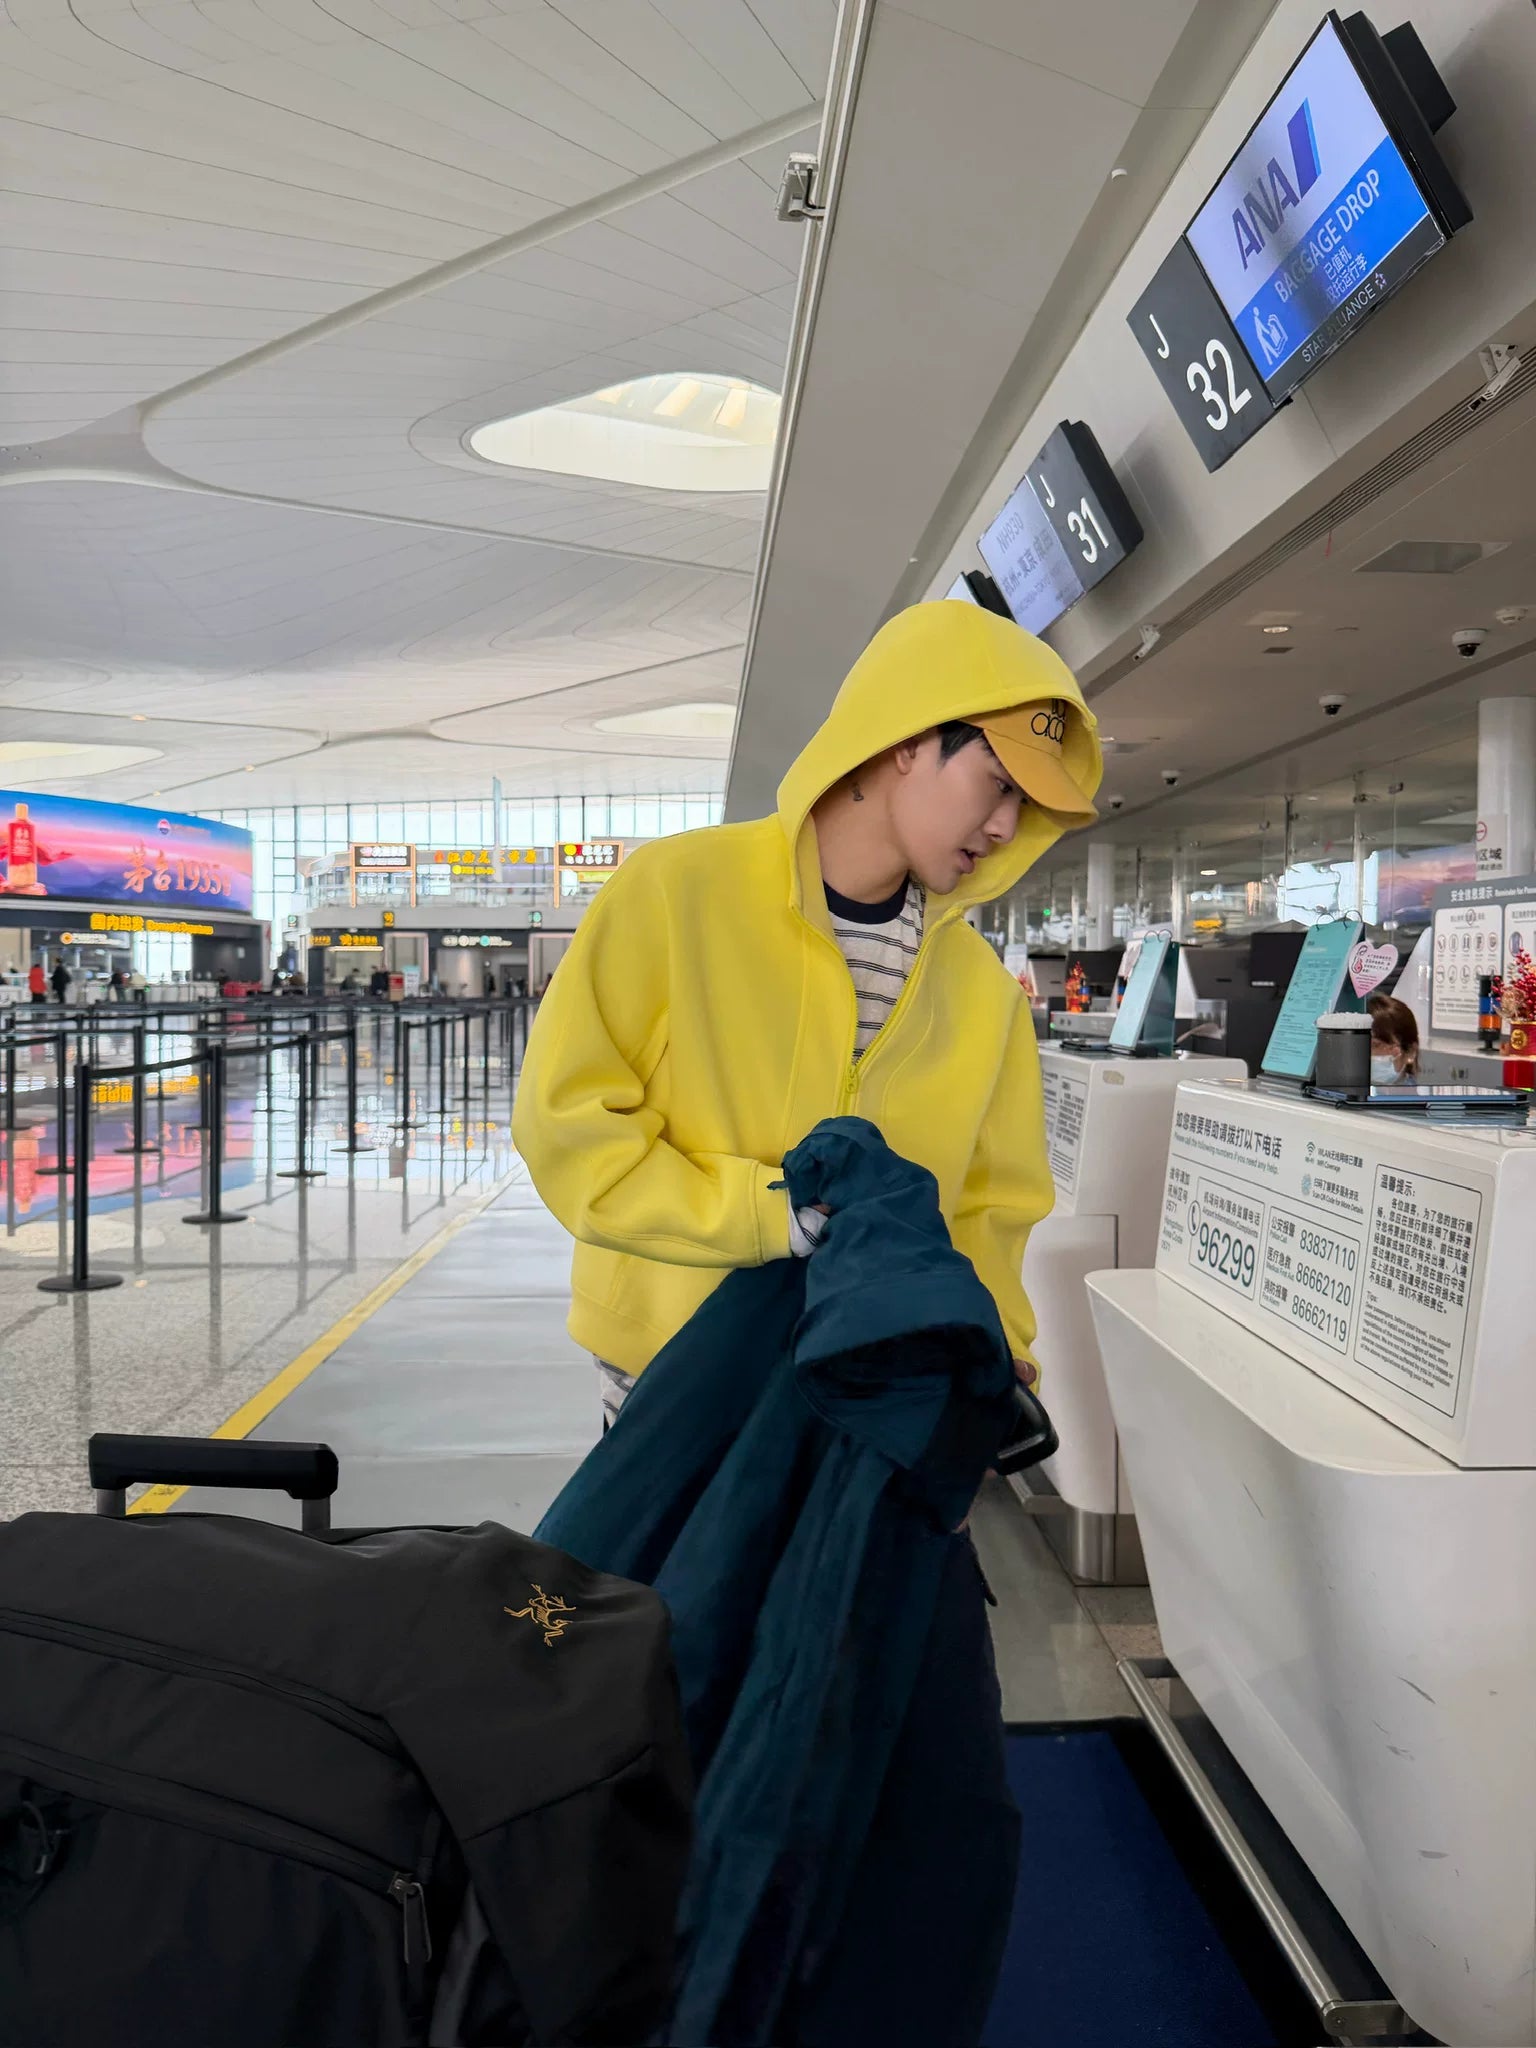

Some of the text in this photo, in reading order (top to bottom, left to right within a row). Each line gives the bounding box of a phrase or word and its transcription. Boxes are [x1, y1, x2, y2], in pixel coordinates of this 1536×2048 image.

[1231, 157, 1300, 271] ANA
[1274, 169, 1381, 304] BAGGAGE DROP
[1323, 246, 1352, 284] 已值机
[1149, 313, 1170, 359] J
[1186, 339, 1252, 431] 32
[1040, 474, 1056, 508] J
[1067, 497, 1109, 563] 31
[1176, 1110, 1282, 1159] 如您需要帮助请拨打以下电话
[1197, 1222, 1255, 1288] 96299
[1271, 1216, 1355, 1271] 公安报警 83837110
[1267, 1246, 1351, 1306] 医疗急救 86662120
[1264, 1277, 1347, 1342] 消防报警 86662119
